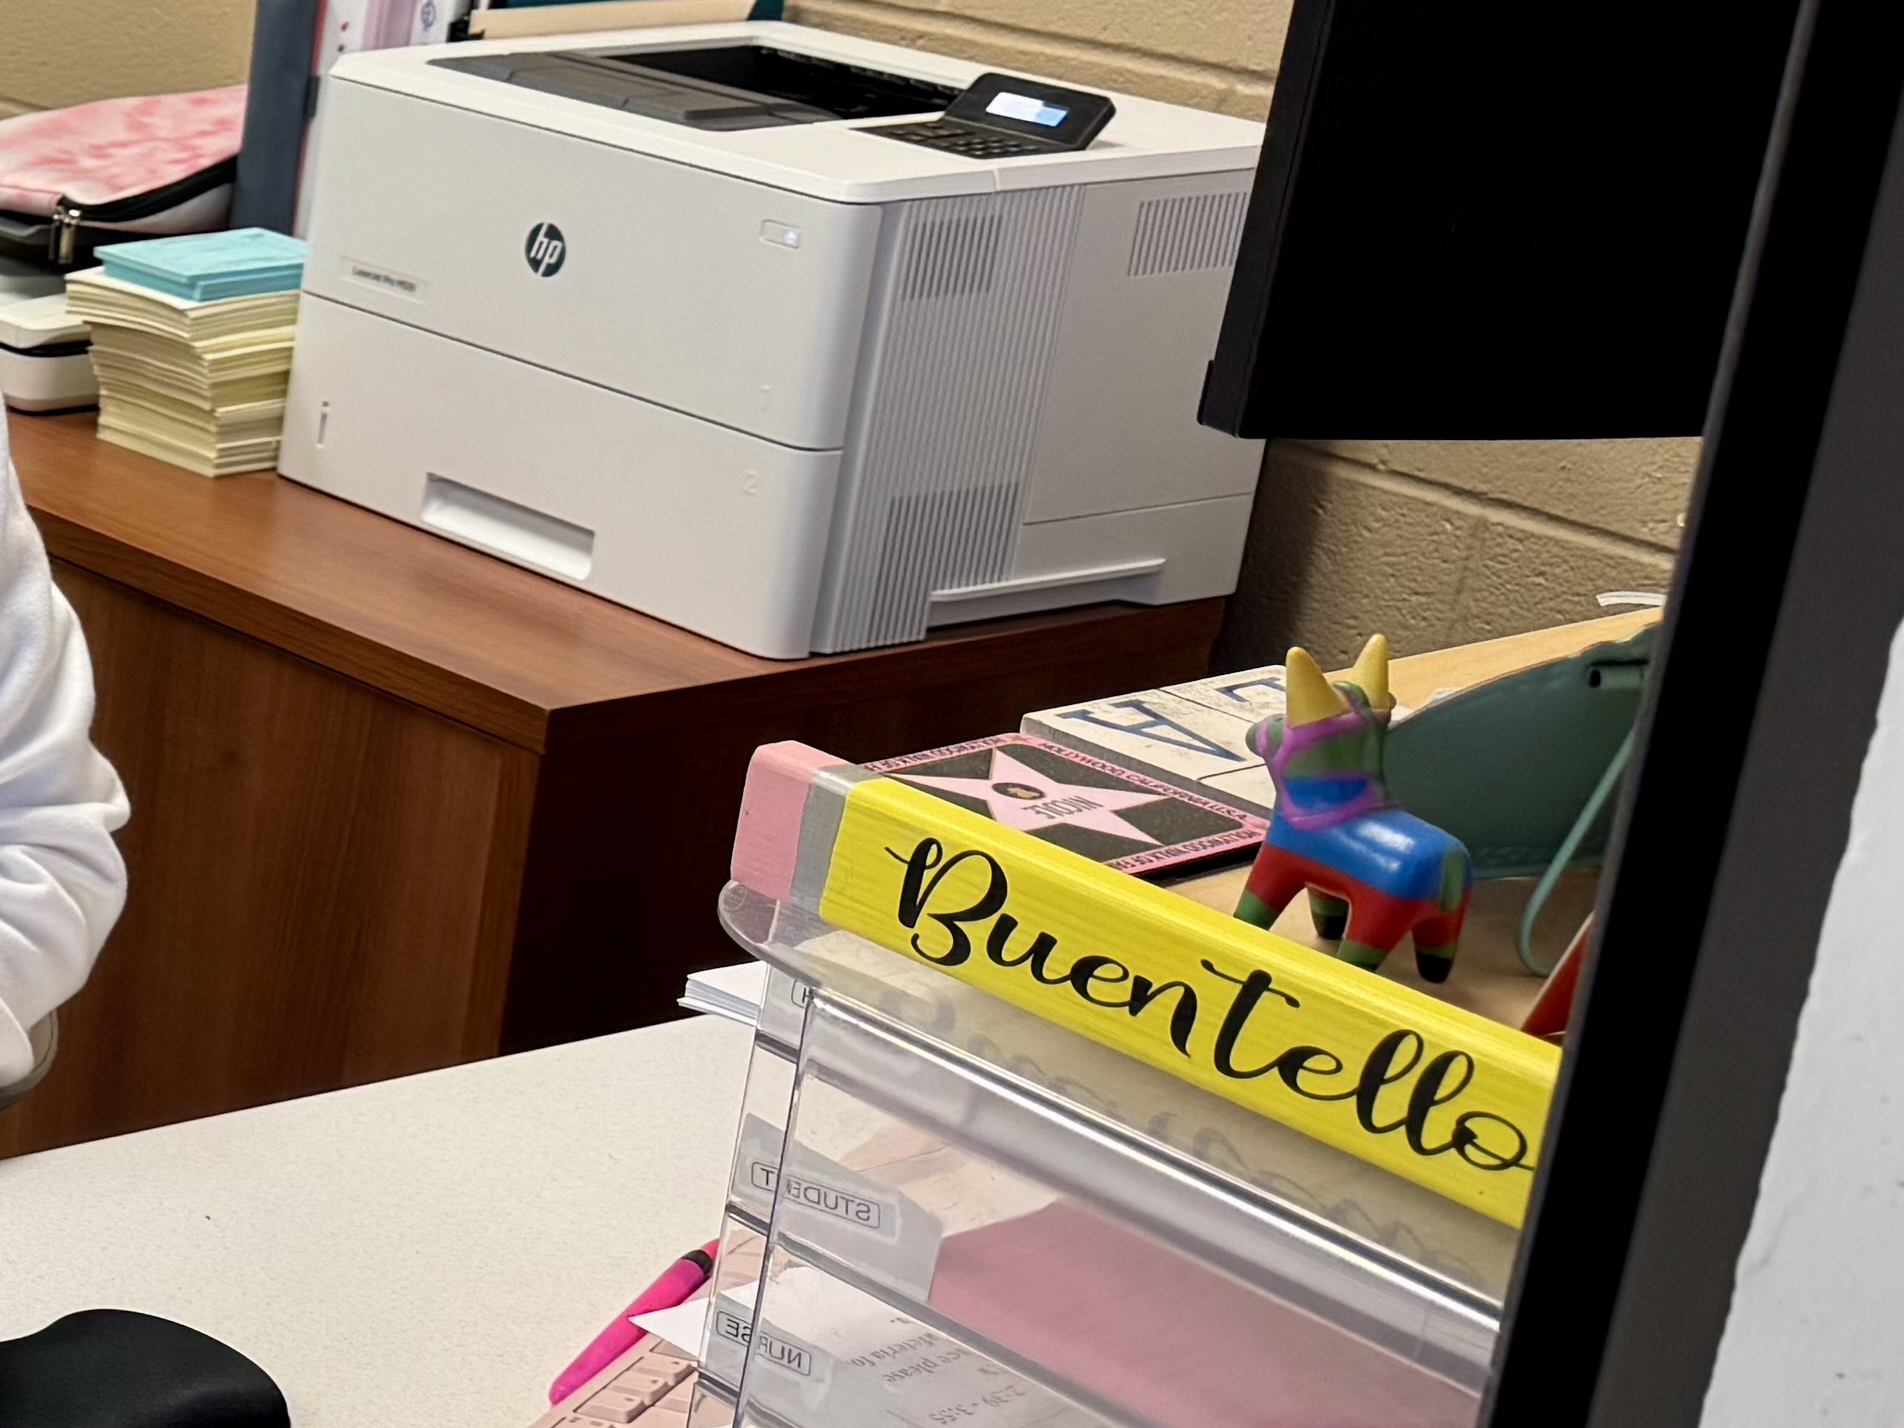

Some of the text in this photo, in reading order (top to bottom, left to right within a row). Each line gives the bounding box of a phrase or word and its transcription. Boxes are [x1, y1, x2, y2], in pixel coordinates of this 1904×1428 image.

[527, 222, 566, 277] hp
[1020, 795, 1104, 821] NICOLE
[884, 837, 1536, 1172] Buentello
